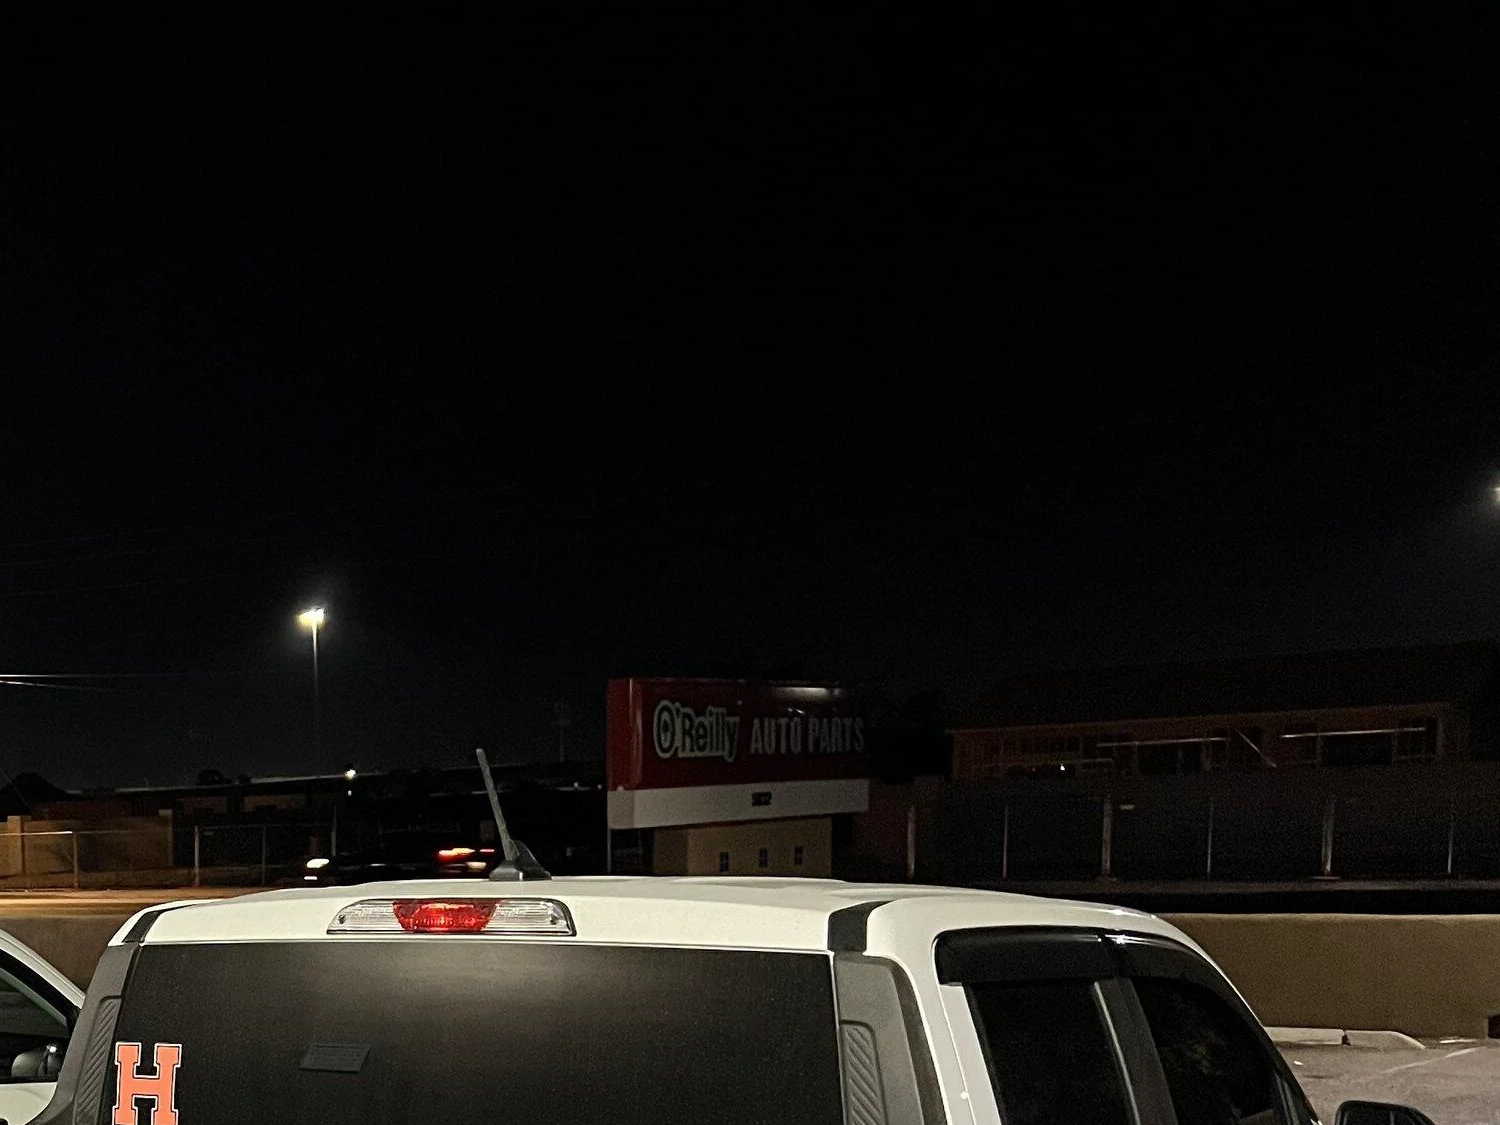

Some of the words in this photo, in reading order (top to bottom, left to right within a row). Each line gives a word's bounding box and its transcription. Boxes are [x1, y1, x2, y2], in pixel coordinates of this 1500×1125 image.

[654, 701, 739, 762] O'Reilly
[751, 716, 802, 755] AUTO
[808, 716, 864, 754] PARTS
